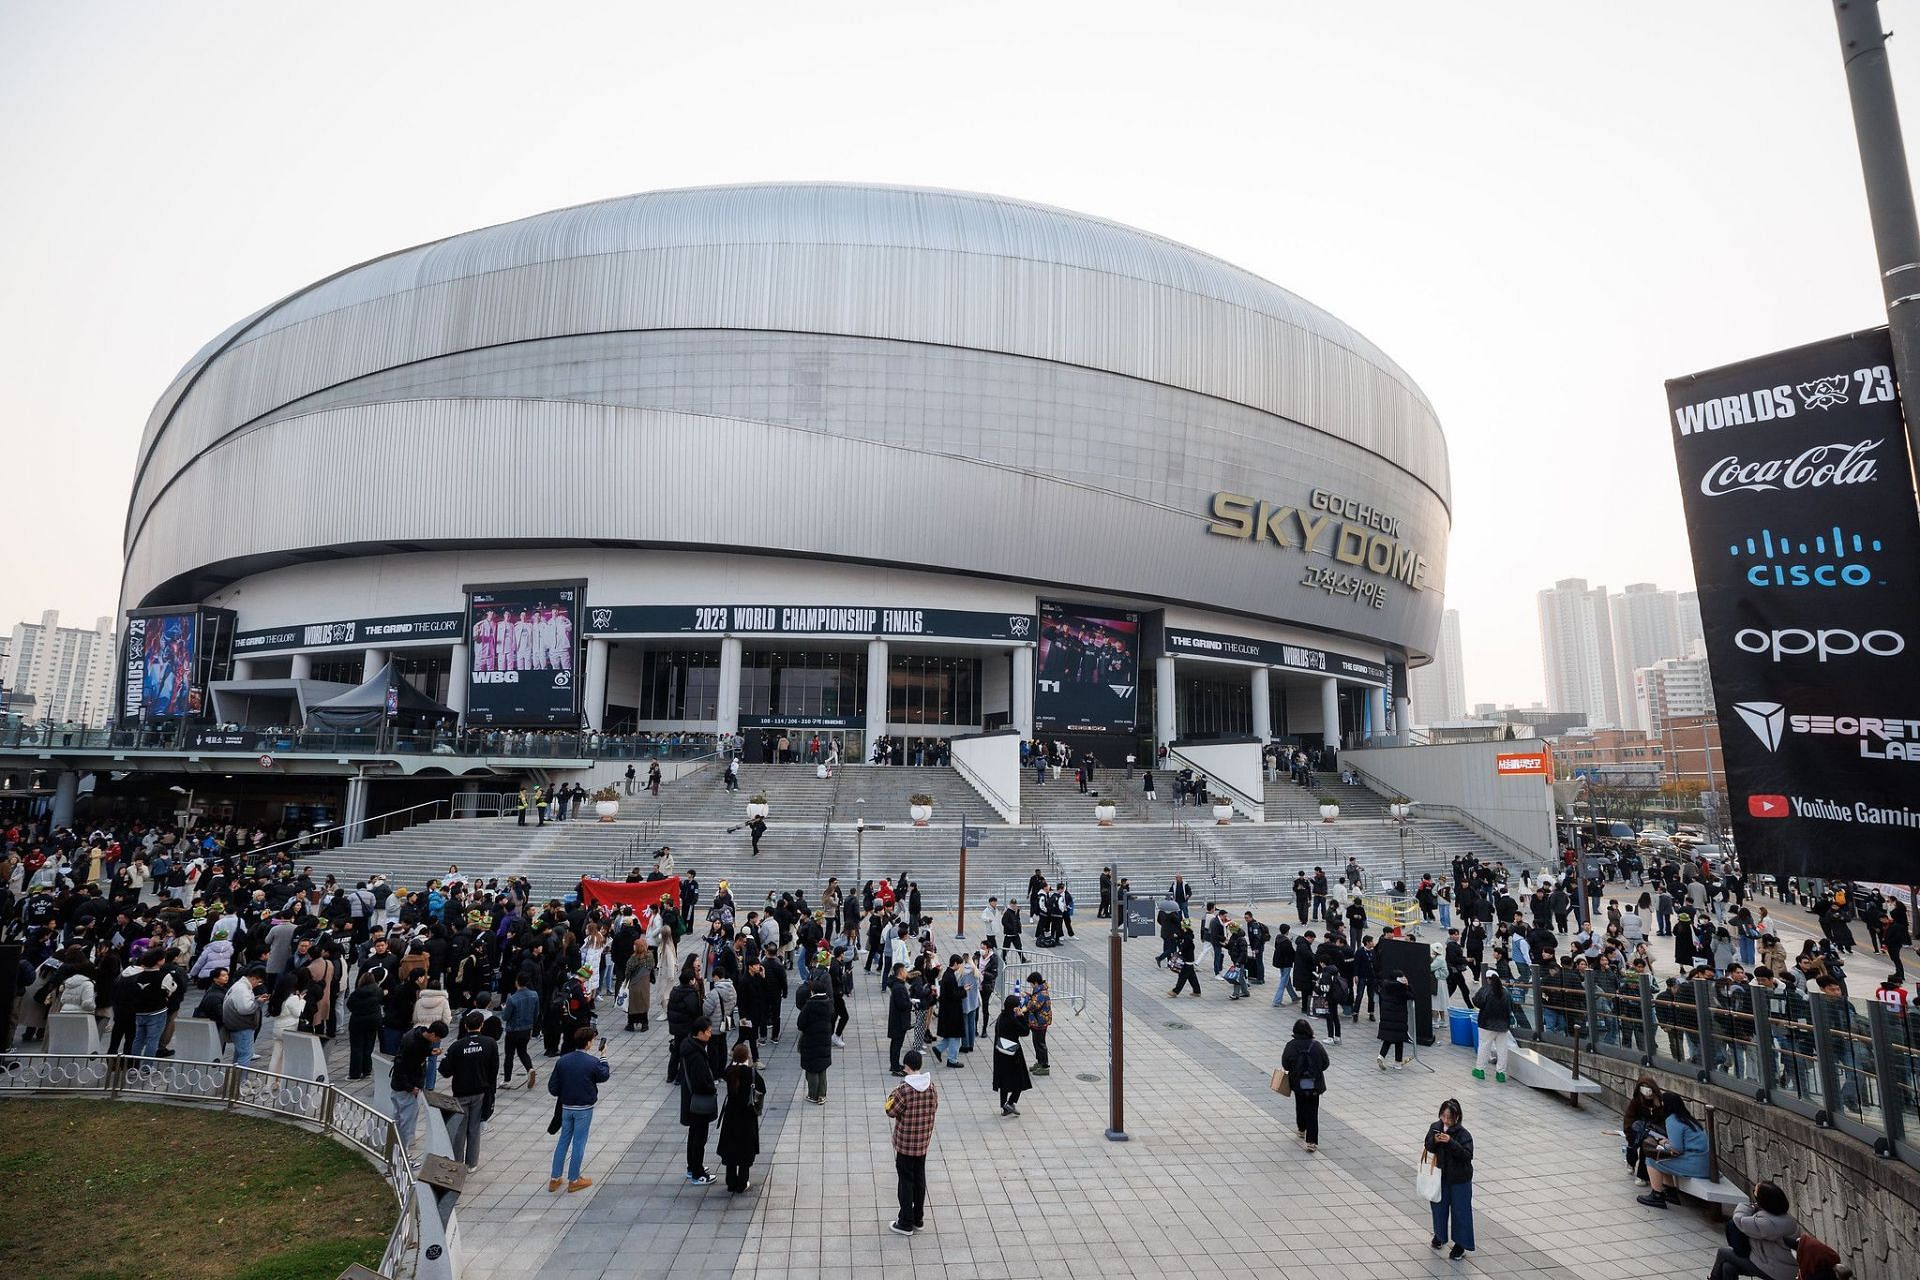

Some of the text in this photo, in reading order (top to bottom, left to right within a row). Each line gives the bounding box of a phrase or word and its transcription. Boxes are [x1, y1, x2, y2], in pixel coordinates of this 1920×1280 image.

[1675, 365, 1896, 436] WORLDS 23
[1700, 438, 1885, 497] Coca-Cola
[1312, 488, 1401, 539] GOCHEOK
[1208, 491, 1431, 592] SKY DOME
[1300, 566, 1387, 609] 고척스카이돔
[365, 621, 457, 635] THE GRIND THE GLORY
[695, 607, 923, 633] 2023 WORLD CHAMPIONSHIP FINALS
[235, 623, 356, 648] THE GRIND THE GLORY WORLDS 23
[1171, 636, 1326, 670] THE GRIND THE GLORY WORLDS 23
[126, 619, 146, 717] WORLDS 23
[472, 671, 519, 684] WBG
[1342, 661, 1353, 670] THE
[1353, 664, 1368, 674] GRIND
[1038, 680, 1060, 693] T1
[1790, 714, 1920, 741] SECRET
[1791, 796, 1852, 822] YouTube
[463, 1046, 482, 1054] KERIA
